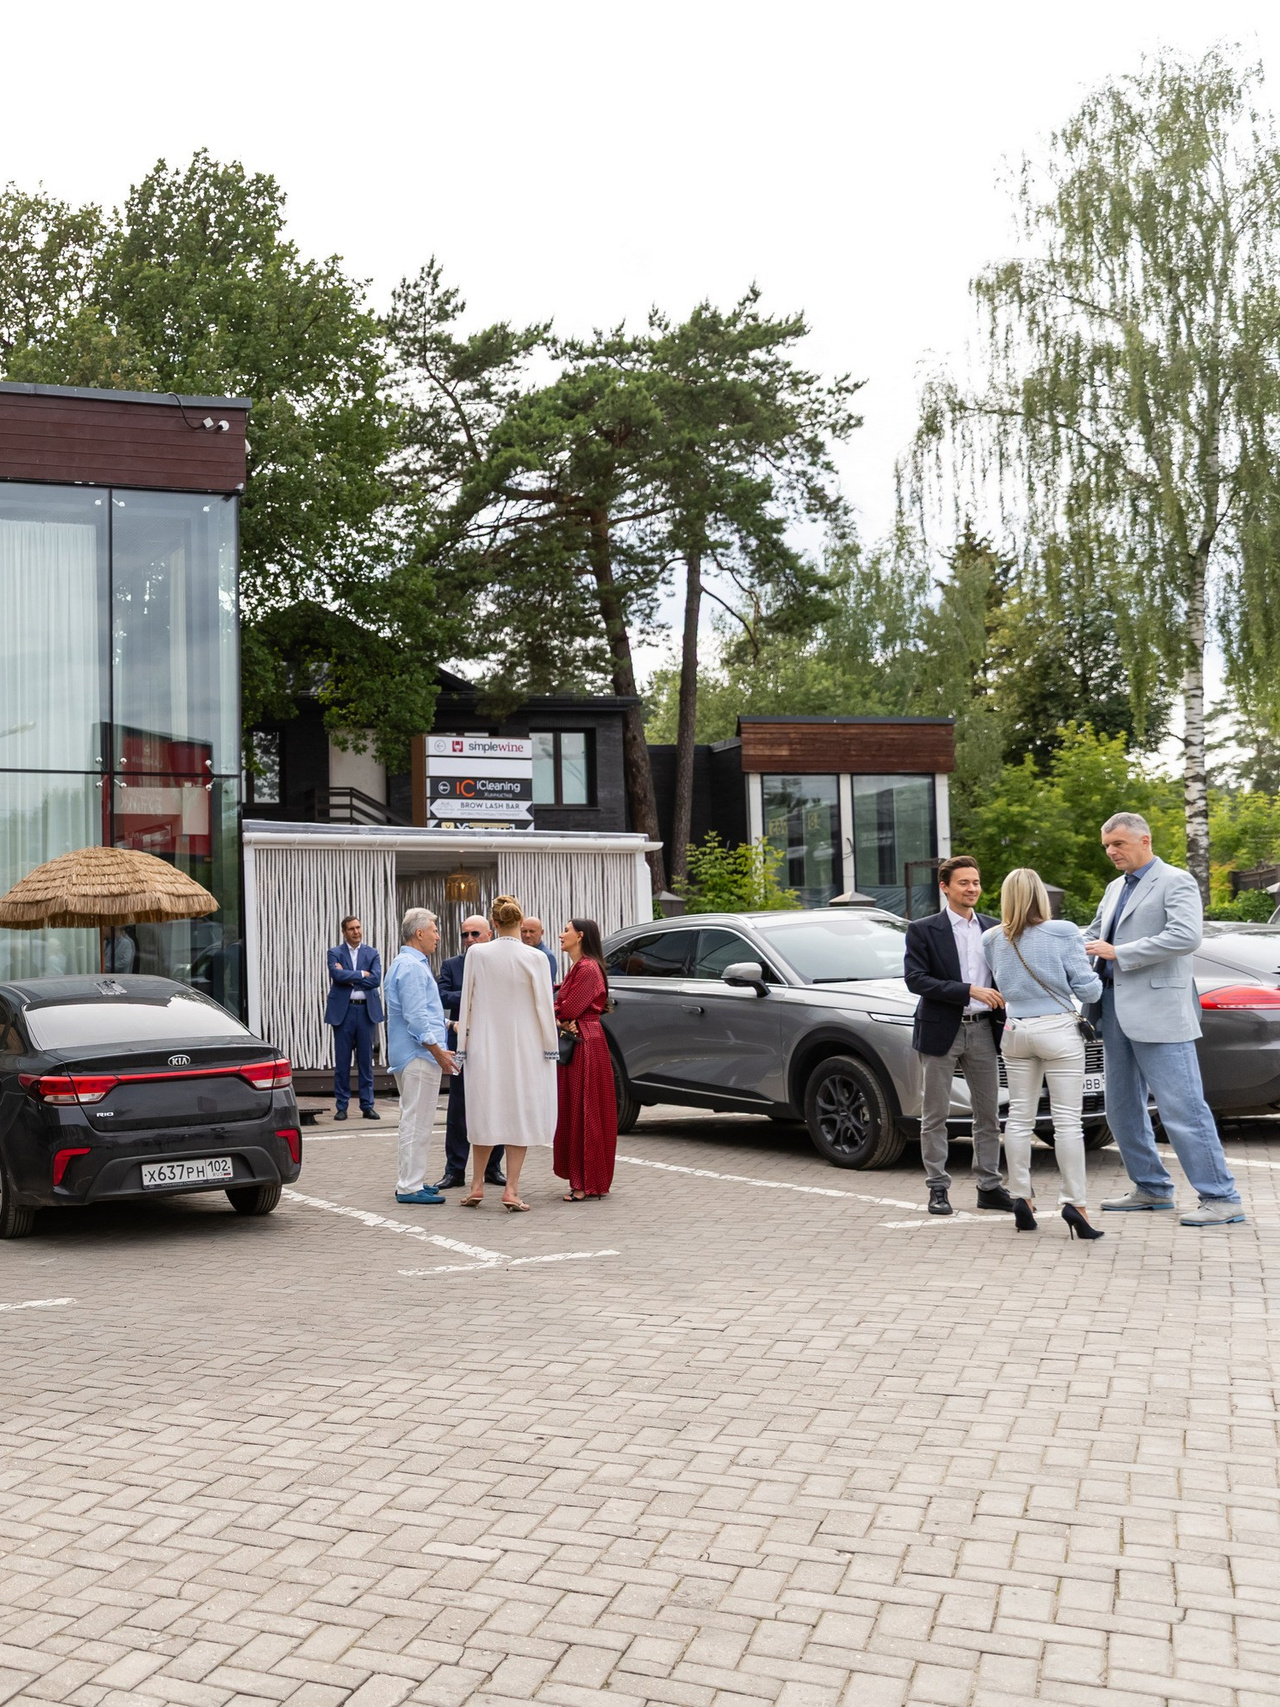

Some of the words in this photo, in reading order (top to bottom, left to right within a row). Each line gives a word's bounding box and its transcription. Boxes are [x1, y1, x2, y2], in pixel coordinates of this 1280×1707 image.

[468, 740, 524, 754] simplewine
[476, 780, 521, 793] iCleaning
[172, 1057, 188, 1066] KIA
[207, 1160, 228, 1173] 102
